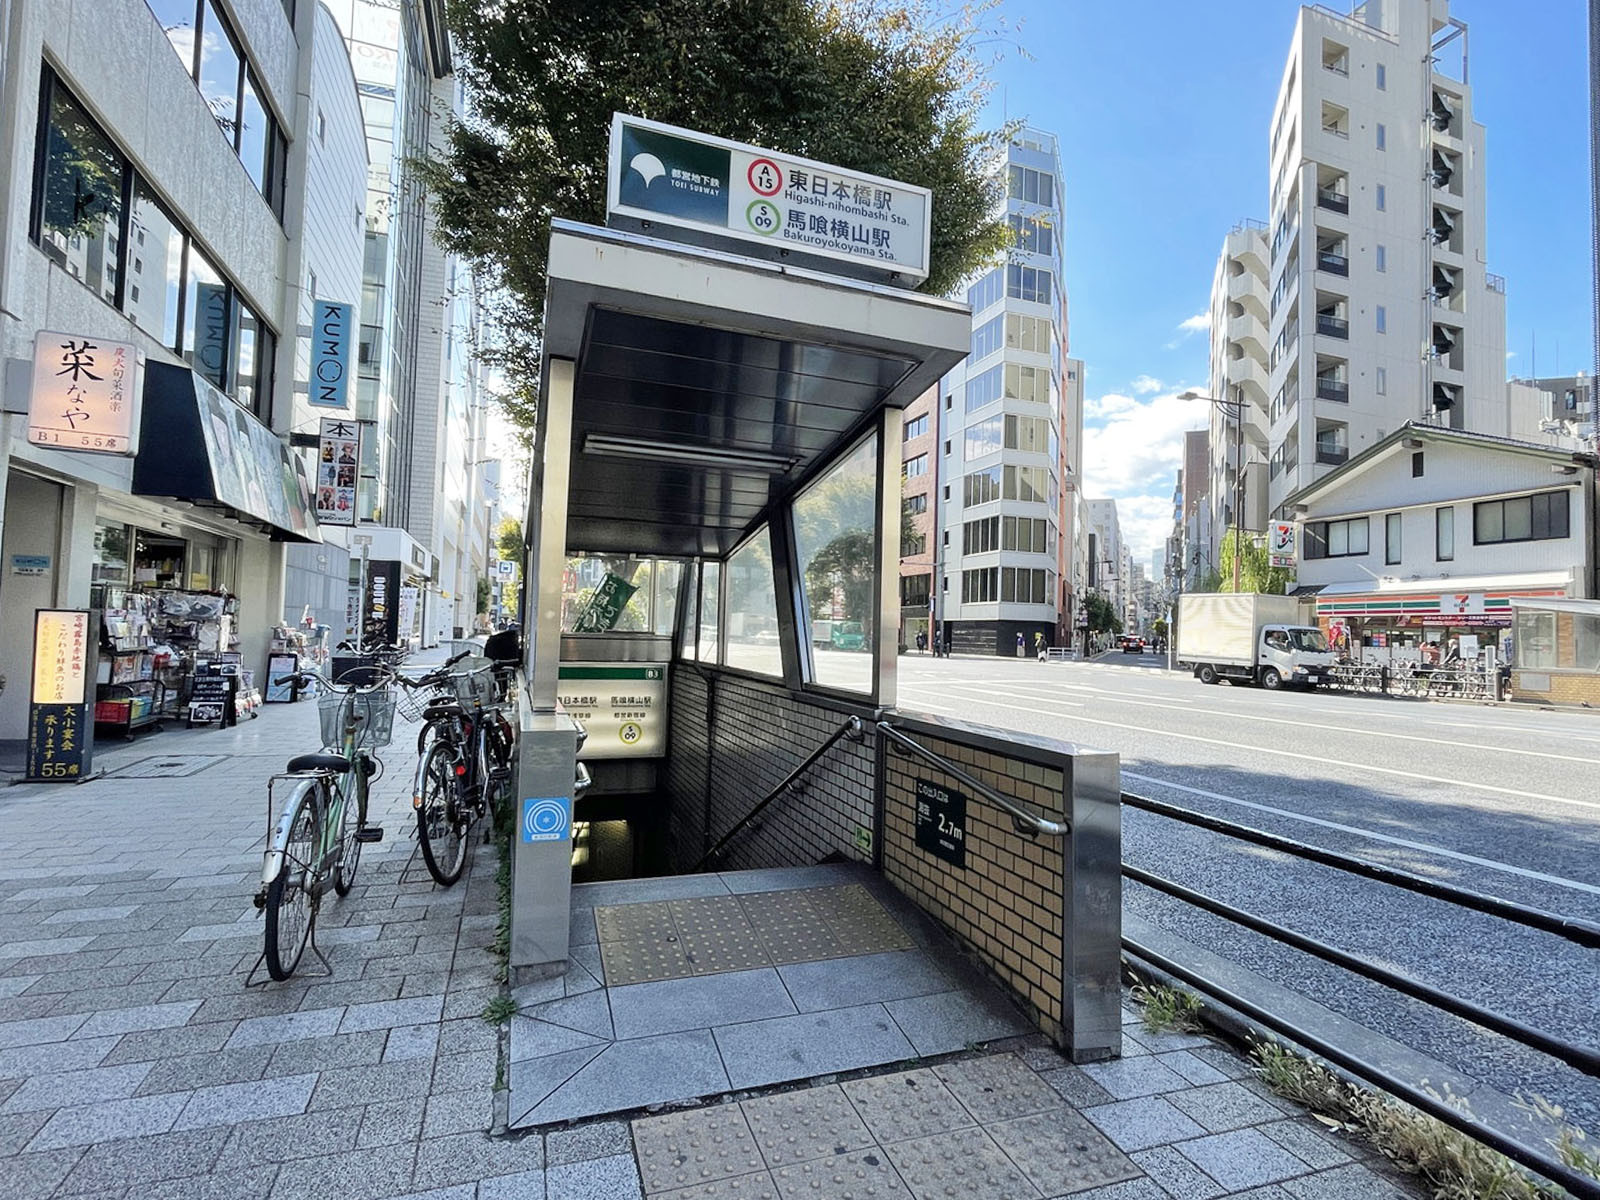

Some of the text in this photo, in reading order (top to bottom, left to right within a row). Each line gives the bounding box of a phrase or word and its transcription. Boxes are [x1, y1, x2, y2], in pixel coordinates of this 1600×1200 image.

[671, 168, 720, 188] 都営地下鉄
[761, 165, 771, 177] A
[671, 179, 720, 197] TOEI SUBWAY
[757, 176, 773, 190] 15
[788, 169, 893, 212] 東日本橋駅
[760, 205, 768, 217] S
[784, 189, 910, 227] Higashi-nihombashi Sta.
[755, 215, 772, 229] 09
[786, 209, 891, 249] 馬喰横山駅
[783, 228, 897, 262] Bakuroyokoyama Sta.
[316, 305, 344, 402] KUMON
[37, 431, 60, 443] B1
[326, 422, 355, 438] 本
[81, 436, 117, 449] 55席
[371, 575, 387, 620] DOUTOR
[43, 714, 58, 760] 承ります
[61, 705, 77, 752] 大小宴会
[624, 732, 637, 740] 09
[41, 762, 79, 777] 55席
[938, 813, 963, 841] 2.7m
